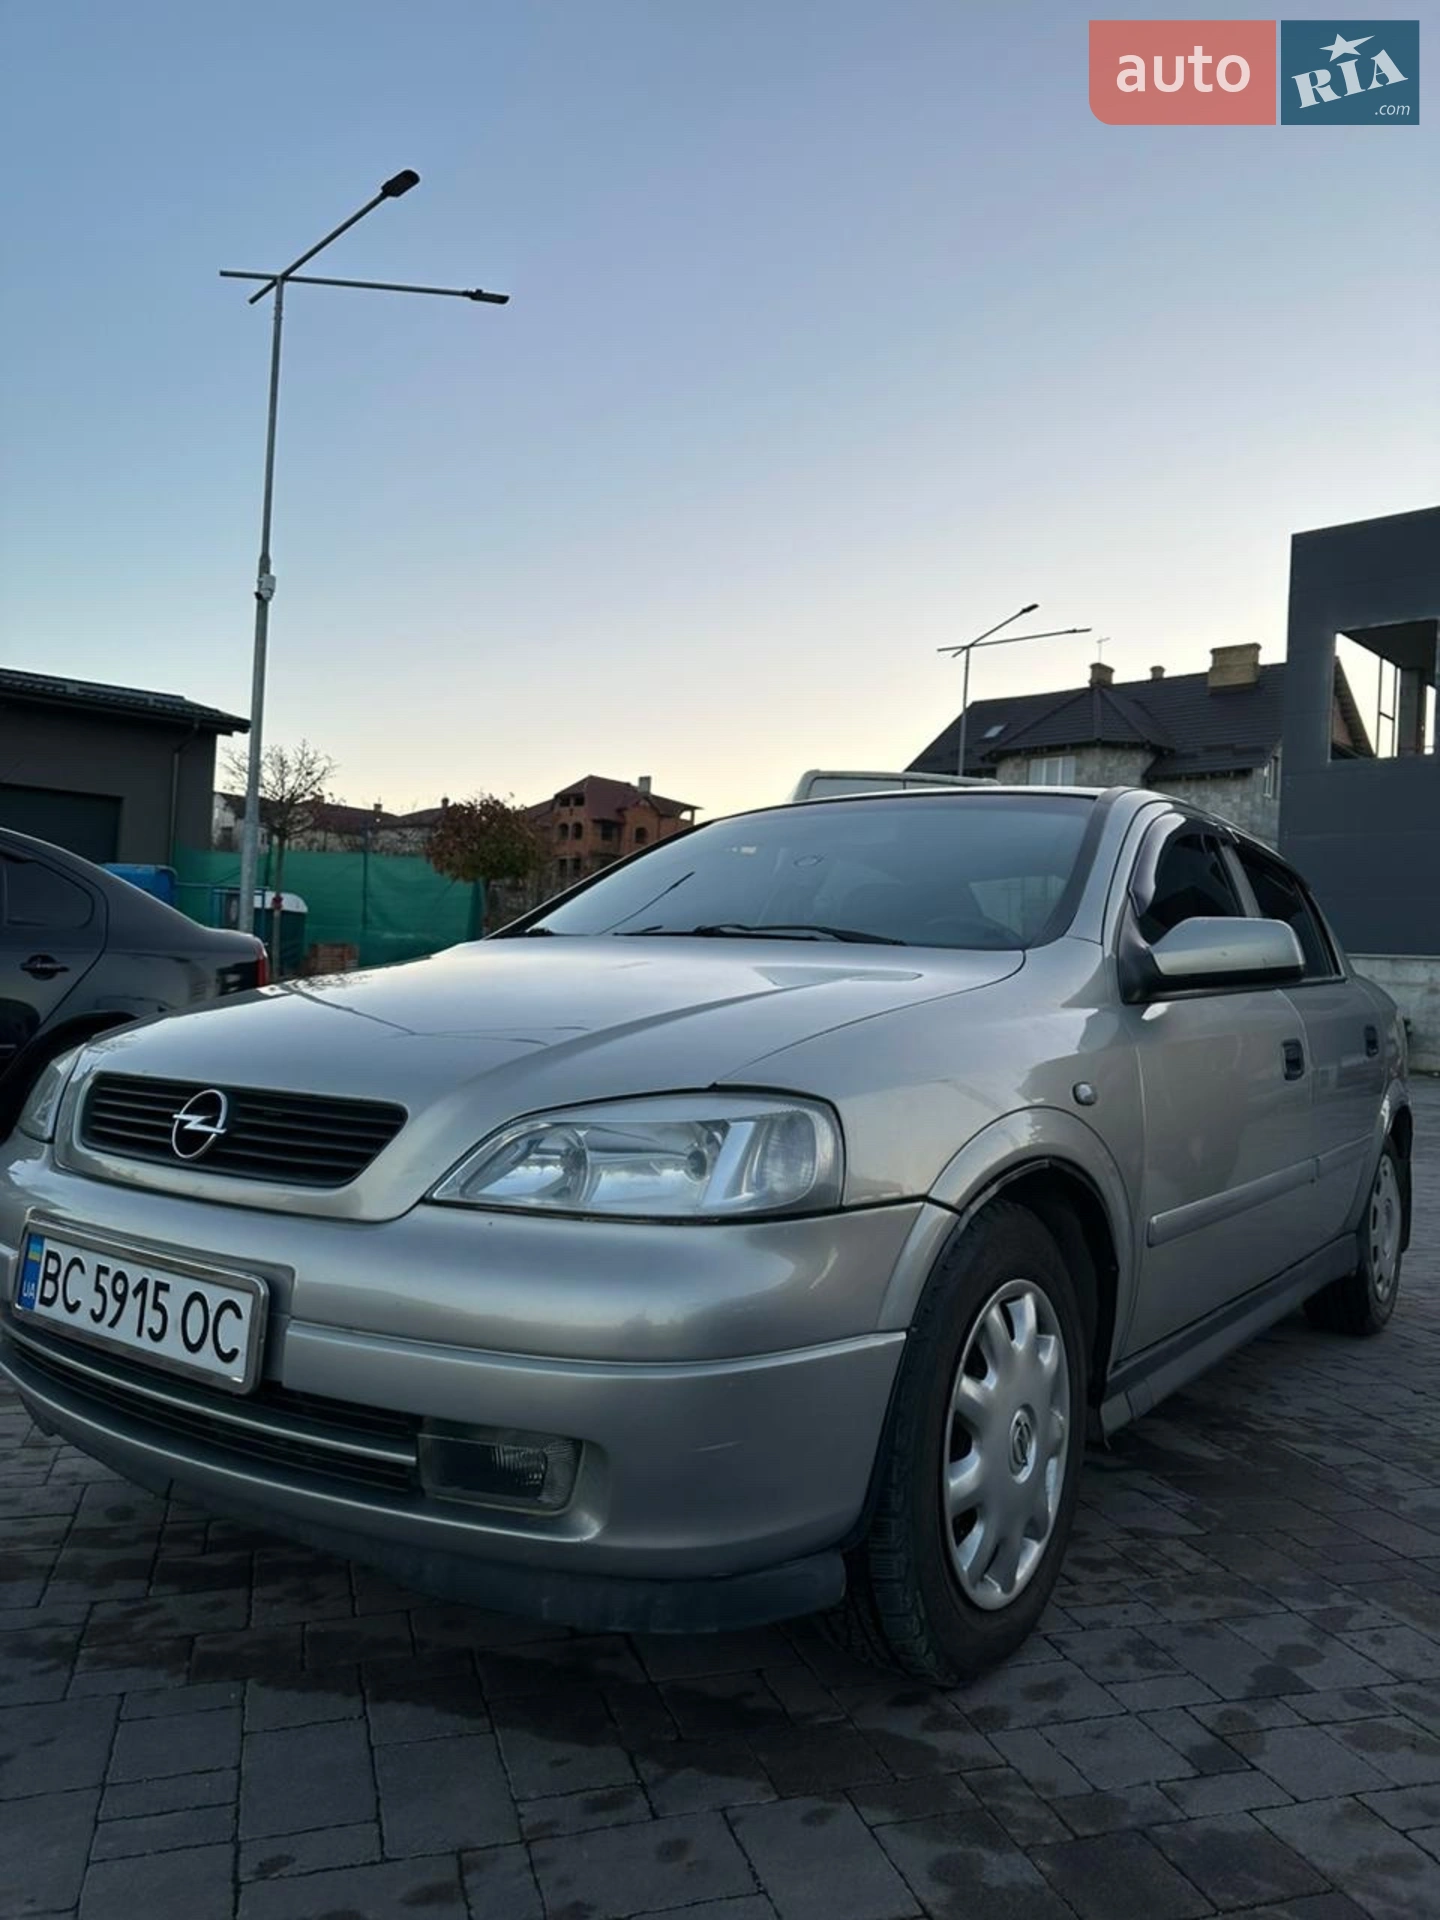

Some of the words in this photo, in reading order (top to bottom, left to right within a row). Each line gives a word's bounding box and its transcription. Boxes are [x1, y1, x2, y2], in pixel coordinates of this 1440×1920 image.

[21, 1280, 36, 1301] UA
[38, 1248, 86, 1314] BC
[90, 1263, 171, 1343] 5915
[180, 1290, 243, 1364] OC
